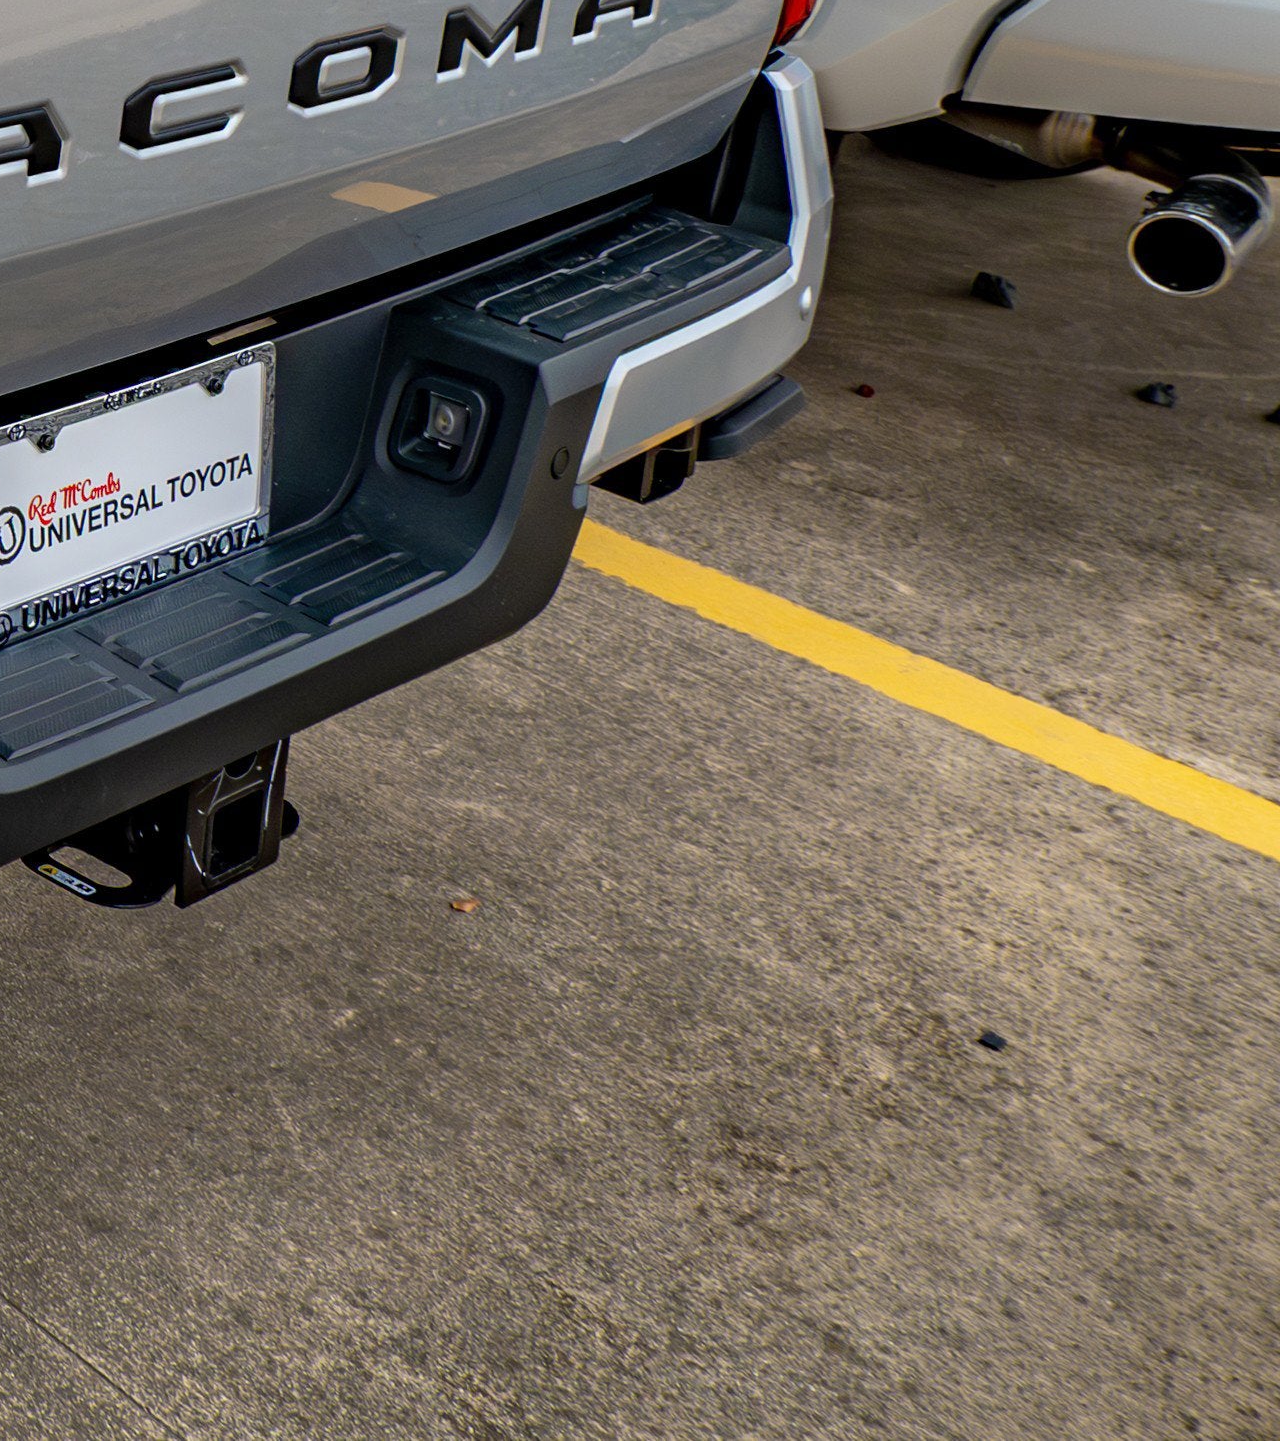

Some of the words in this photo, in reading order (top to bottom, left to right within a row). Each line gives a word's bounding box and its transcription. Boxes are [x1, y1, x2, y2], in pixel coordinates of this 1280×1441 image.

[28, 491, 57, 525] Red
[59, 472, 121, 509] McCombs
[29, 484, 163, 552] UNIVERSAL
[167, 453, 253, 502] TOYOTA
[21, 556, 167, 632] UNIVERSAL
[169, 520, 264, 574] TOYOTA
